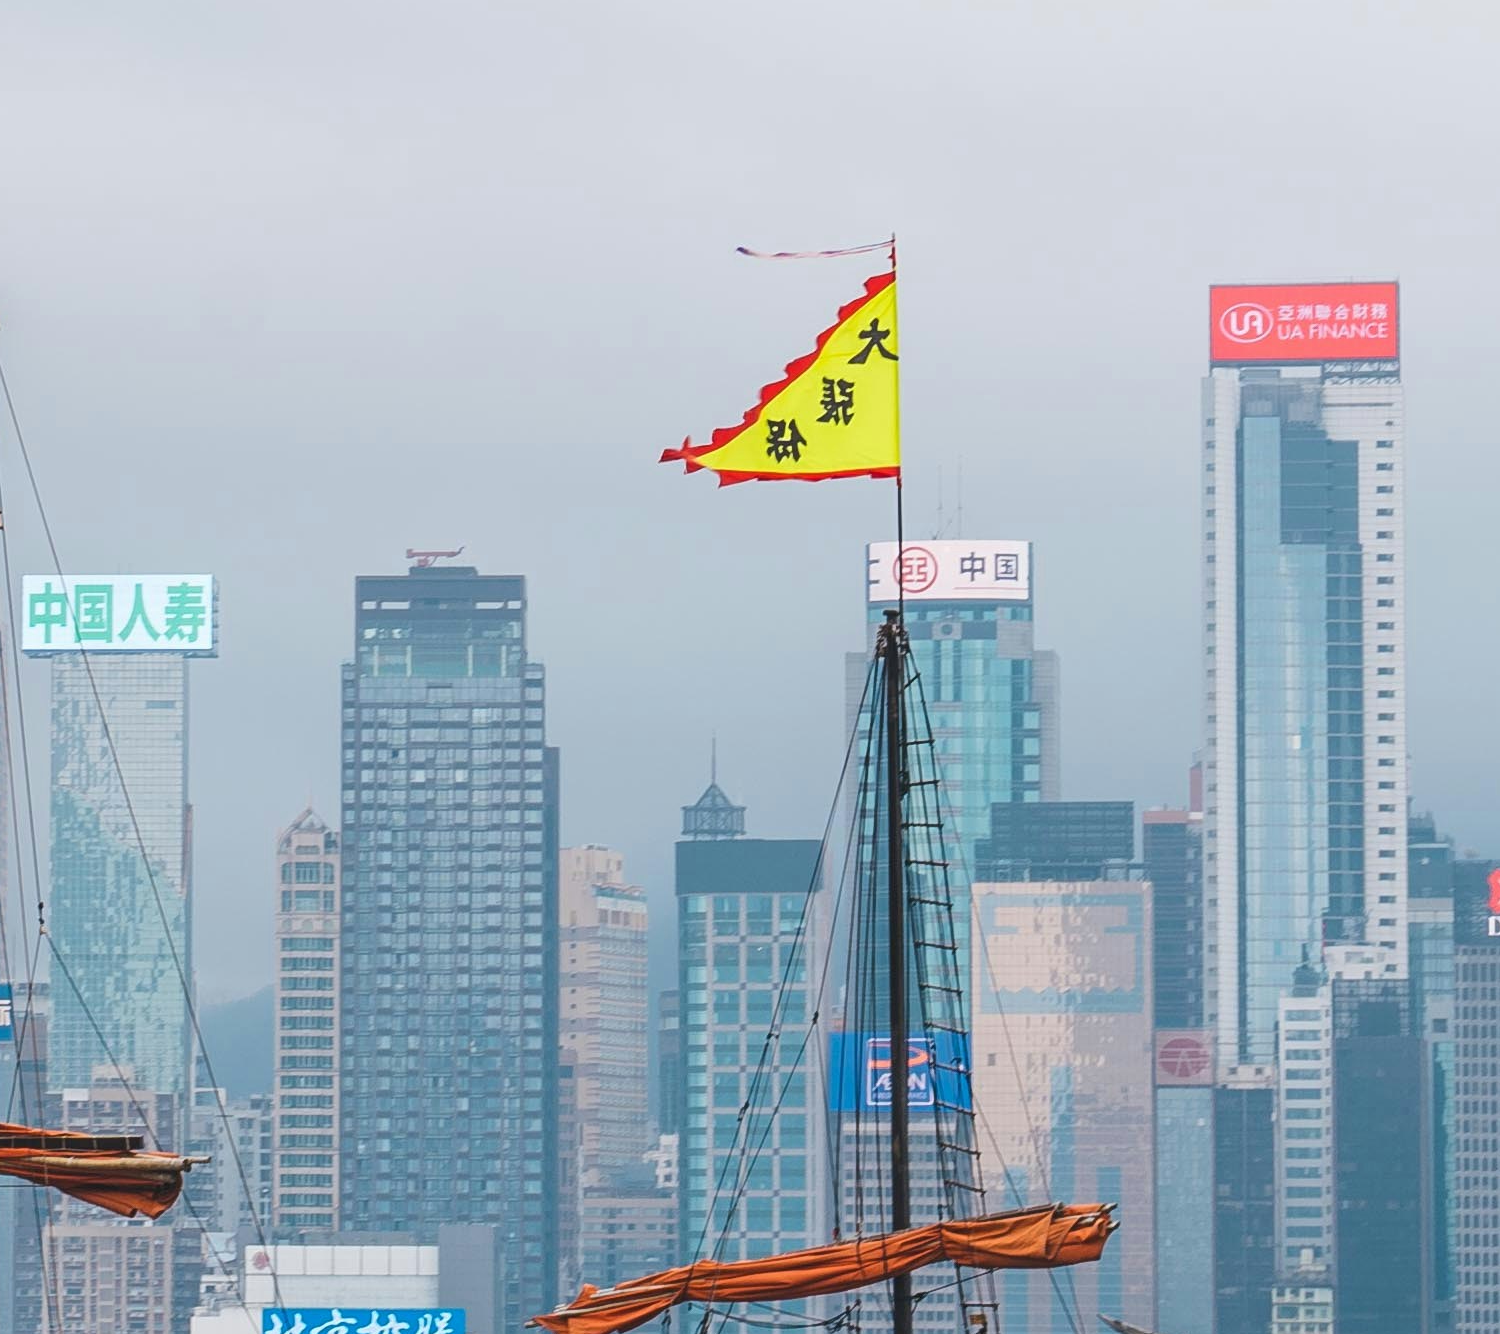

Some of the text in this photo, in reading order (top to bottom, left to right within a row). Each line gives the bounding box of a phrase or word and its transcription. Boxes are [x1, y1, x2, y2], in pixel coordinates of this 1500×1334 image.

[1277, 322, 1388, 340] UA FINANCE
[960, 552, 1019, 581] 中国
[29, 582, 206, 643] 中国人寿
[871, 1072, 927, 1092] AEN
